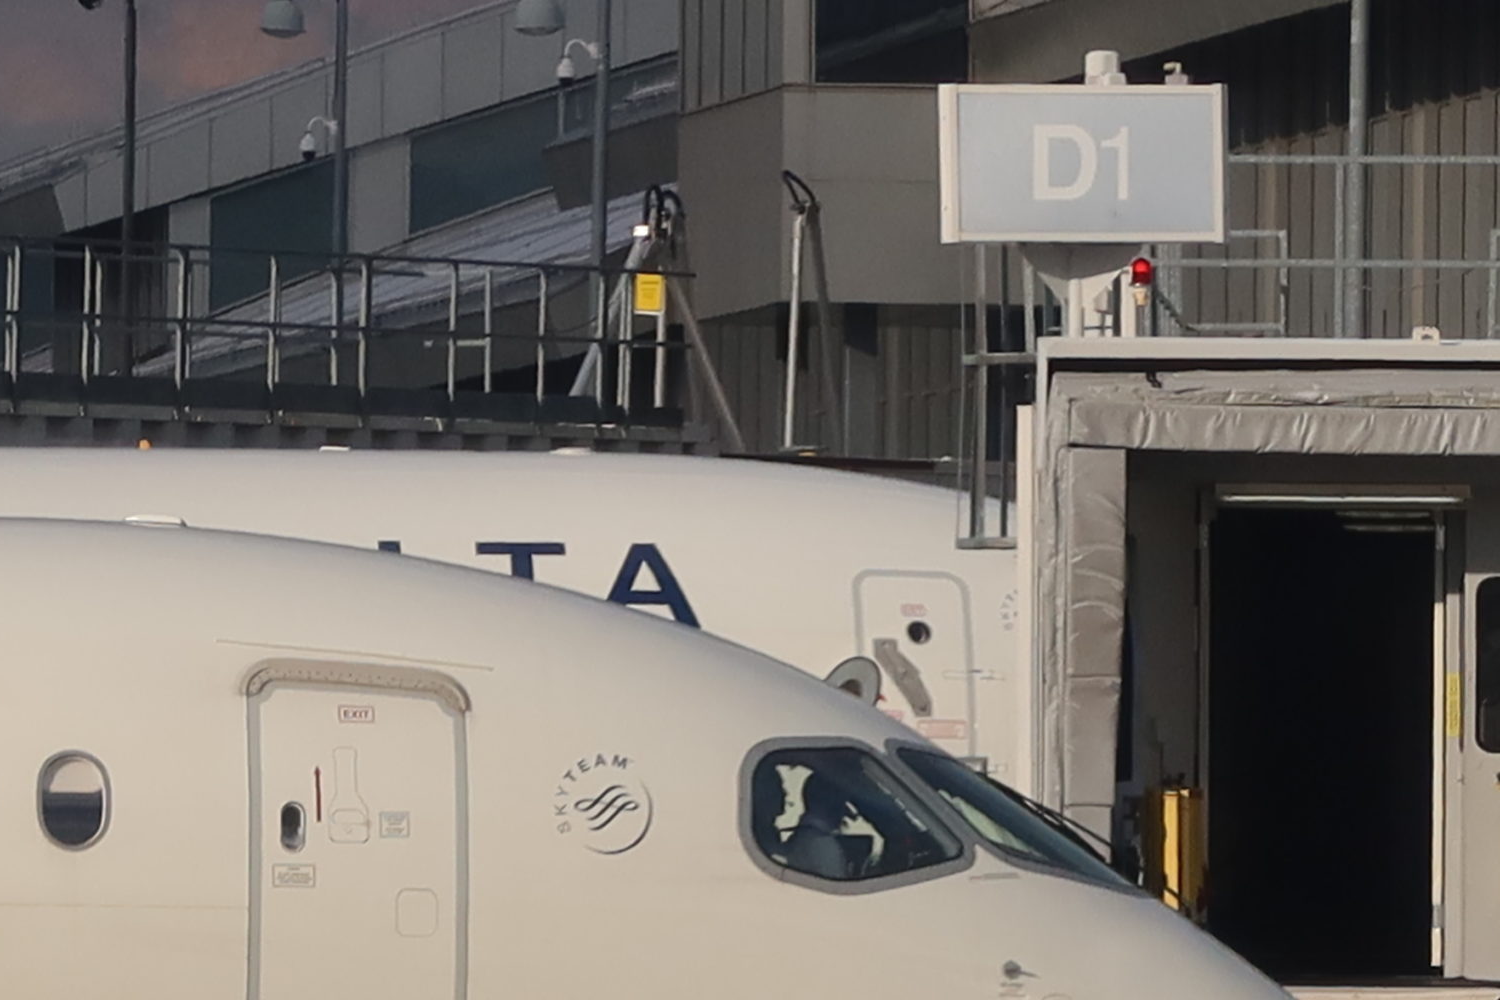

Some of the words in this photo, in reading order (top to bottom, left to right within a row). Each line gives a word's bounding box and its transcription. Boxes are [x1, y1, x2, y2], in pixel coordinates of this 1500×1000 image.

[1031, 124, 1132, 202] D1
[342, 709, 369, 719] EXIT
[554, 753, 628, 834] SKYTEAM
